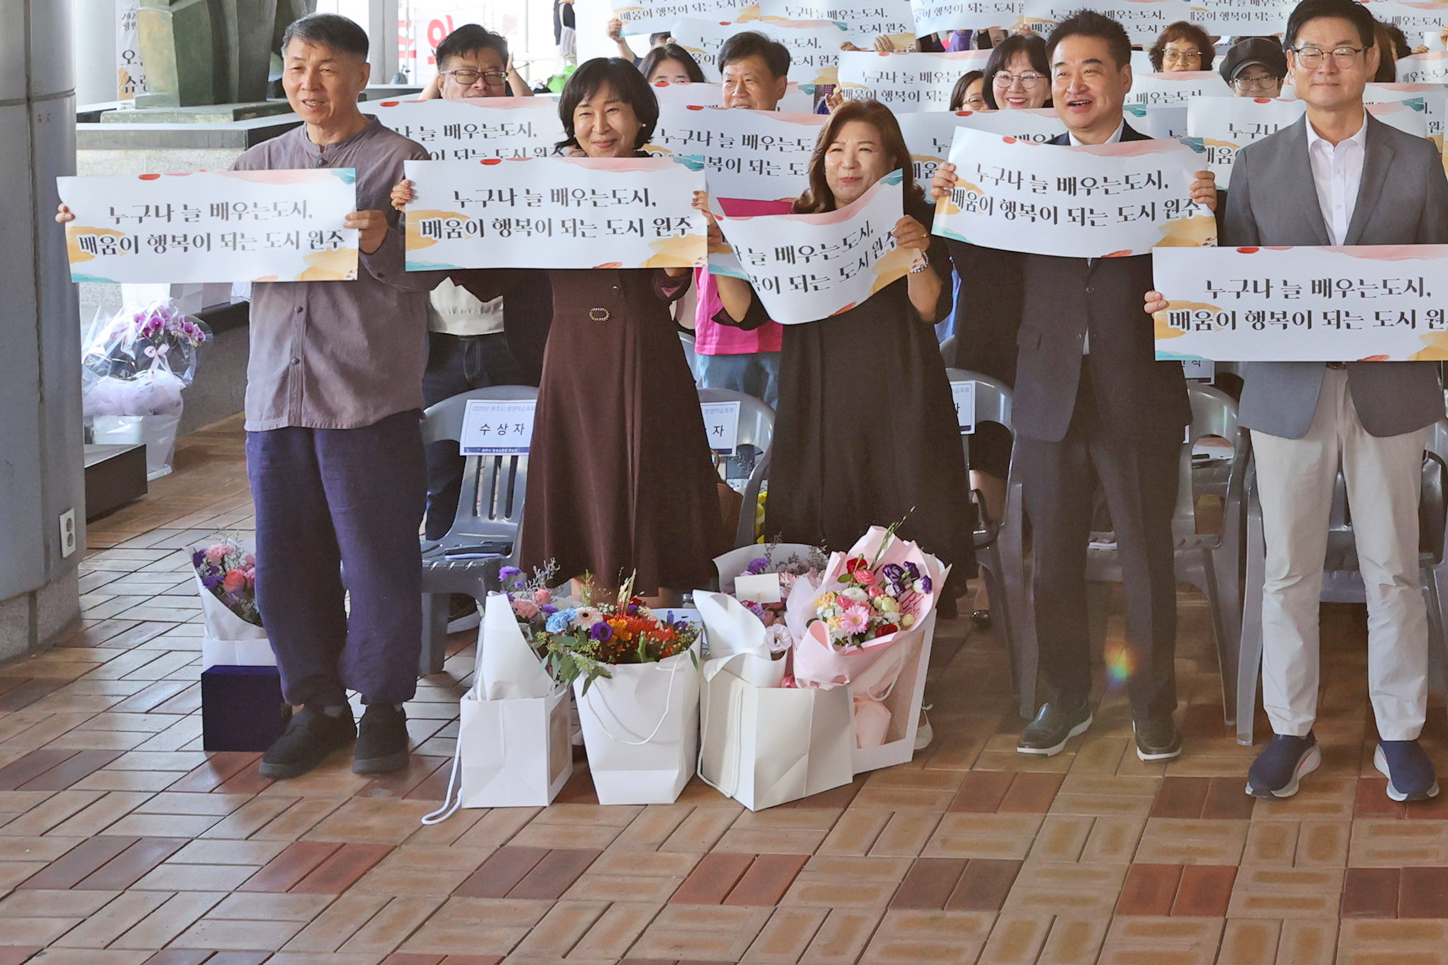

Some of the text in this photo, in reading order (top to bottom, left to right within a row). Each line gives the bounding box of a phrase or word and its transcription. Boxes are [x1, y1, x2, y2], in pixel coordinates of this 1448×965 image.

[863, 72, 914, 84] 누구나 늘
[844, 89, 947, 104] 배움이 행복이 되는
[420, 126, 436, 141] 늘
[662, 129, 734, 148] 누구나 늘
[750, 160, 781, 175] 되는
[977, 164, 1024, 190] 누구나
[1031, 174, 1048, 194] 늘
[454, 188, 517, 208] 누구나
[524, 189, 542, 207] 늘
[953, 190, 1204, 226] 배움이 행복이 되는 도시 원주
[109, 204, 174, 224] 누구나
[182, 204, 201, 222] 늘
[422, 216, 692, 239] 배움이 행복이 되는 도시 원주
[80, 230, 344, 255] 배움이 행복이 되는 도시 원주
[748, 248, 766, 266] 늘
[790, 275, 830, 293] 되는
[839, 250, 869, 280] 도시
[1206, 279, 1273, 299] 누구나
[1281, 280, 1302, 299] 늘
[1170, 311, 1236, 331] 배움이
[1245, 310, 1312, 330] 행복이
[1323, 310, 1364, 329] 되는
[1374, 309, 1415, 329] 도시
